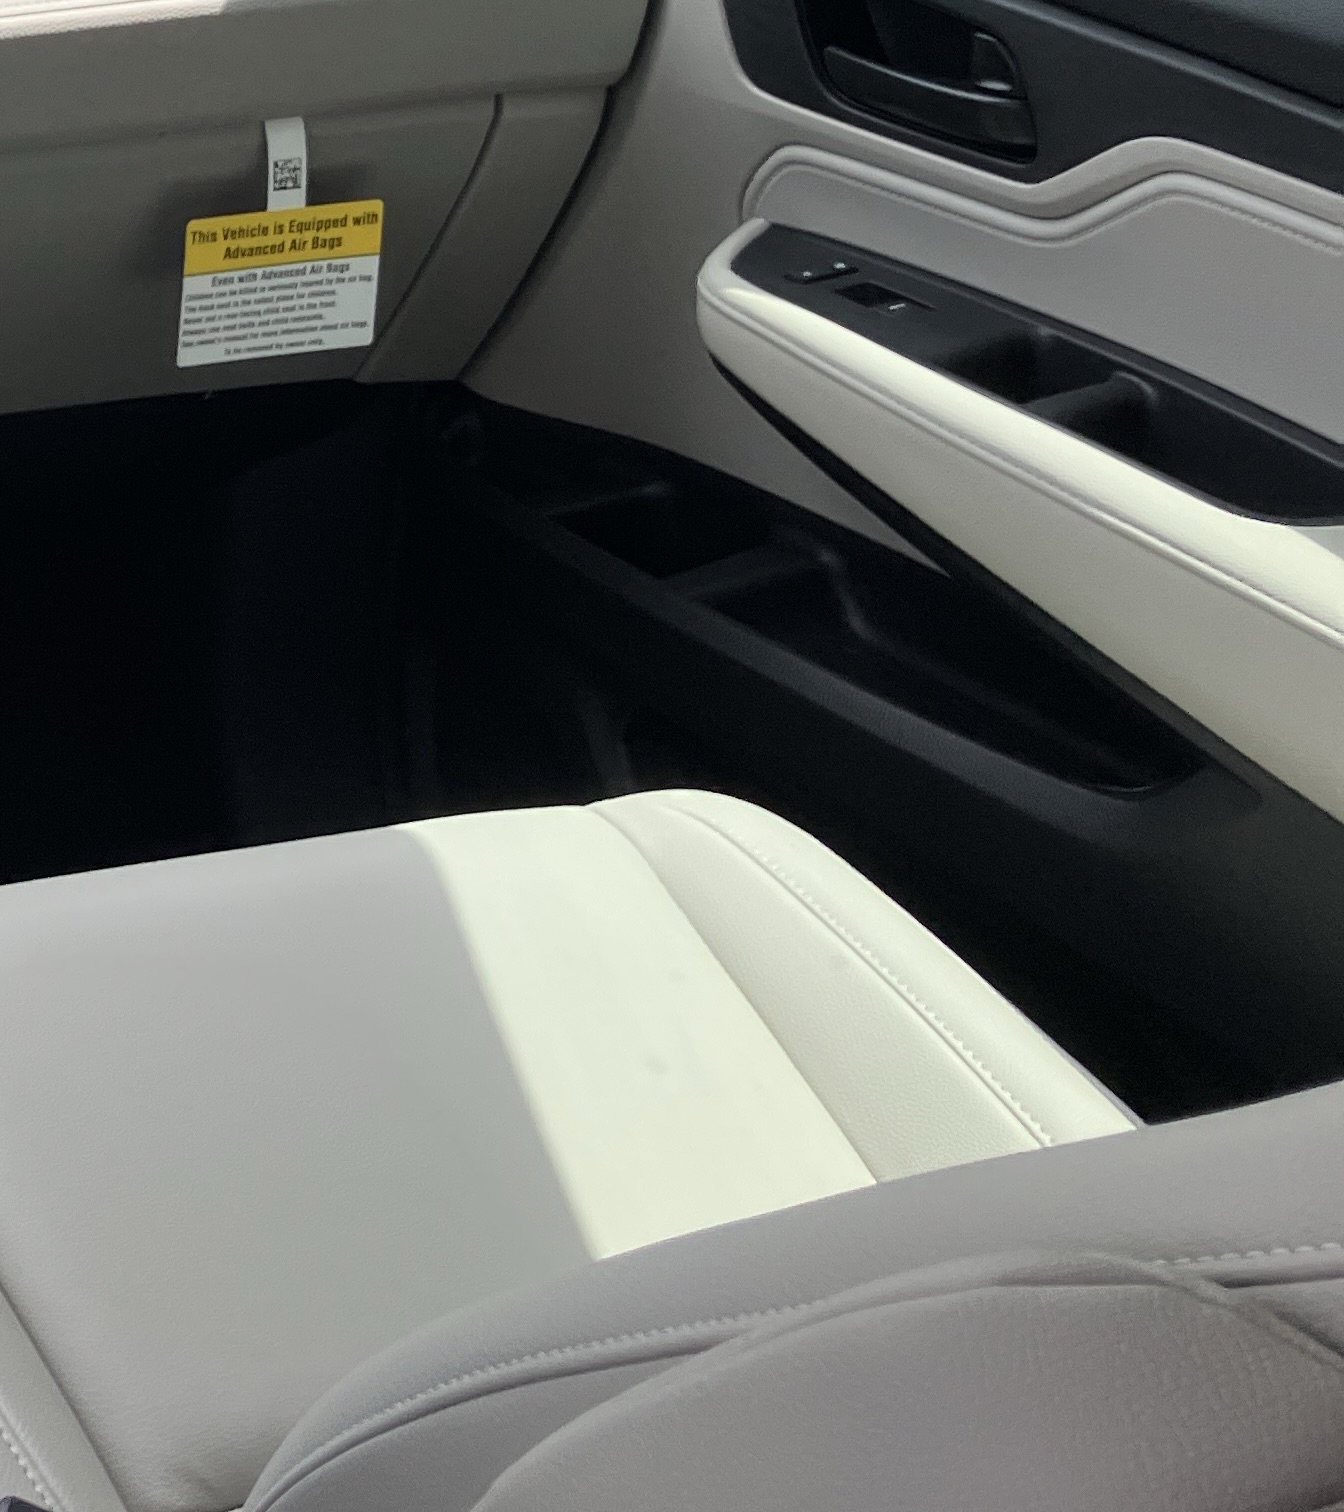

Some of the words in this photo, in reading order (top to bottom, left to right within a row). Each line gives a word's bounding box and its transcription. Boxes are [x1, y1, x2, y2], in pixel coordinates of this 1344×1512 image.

[190, 230, 218, 246] This
[222, 223, 269, 241] Vehicle
[273, 221, 285, 236] is
[288, 213, 348, 234] Equipped
[352, 211, 379, 227] with
[222, 240, 285, 261] Advanced
[289, 237, 309, 252] Air
[312, 235, 343, 251] Bags
[211, 275, 235, 288] Even
[238, 271, 258, 284] with
[261, 265, 307, 281] Advanced
[309, 263, 324, 275] Air
[326, 262, 351, 275] Bags
